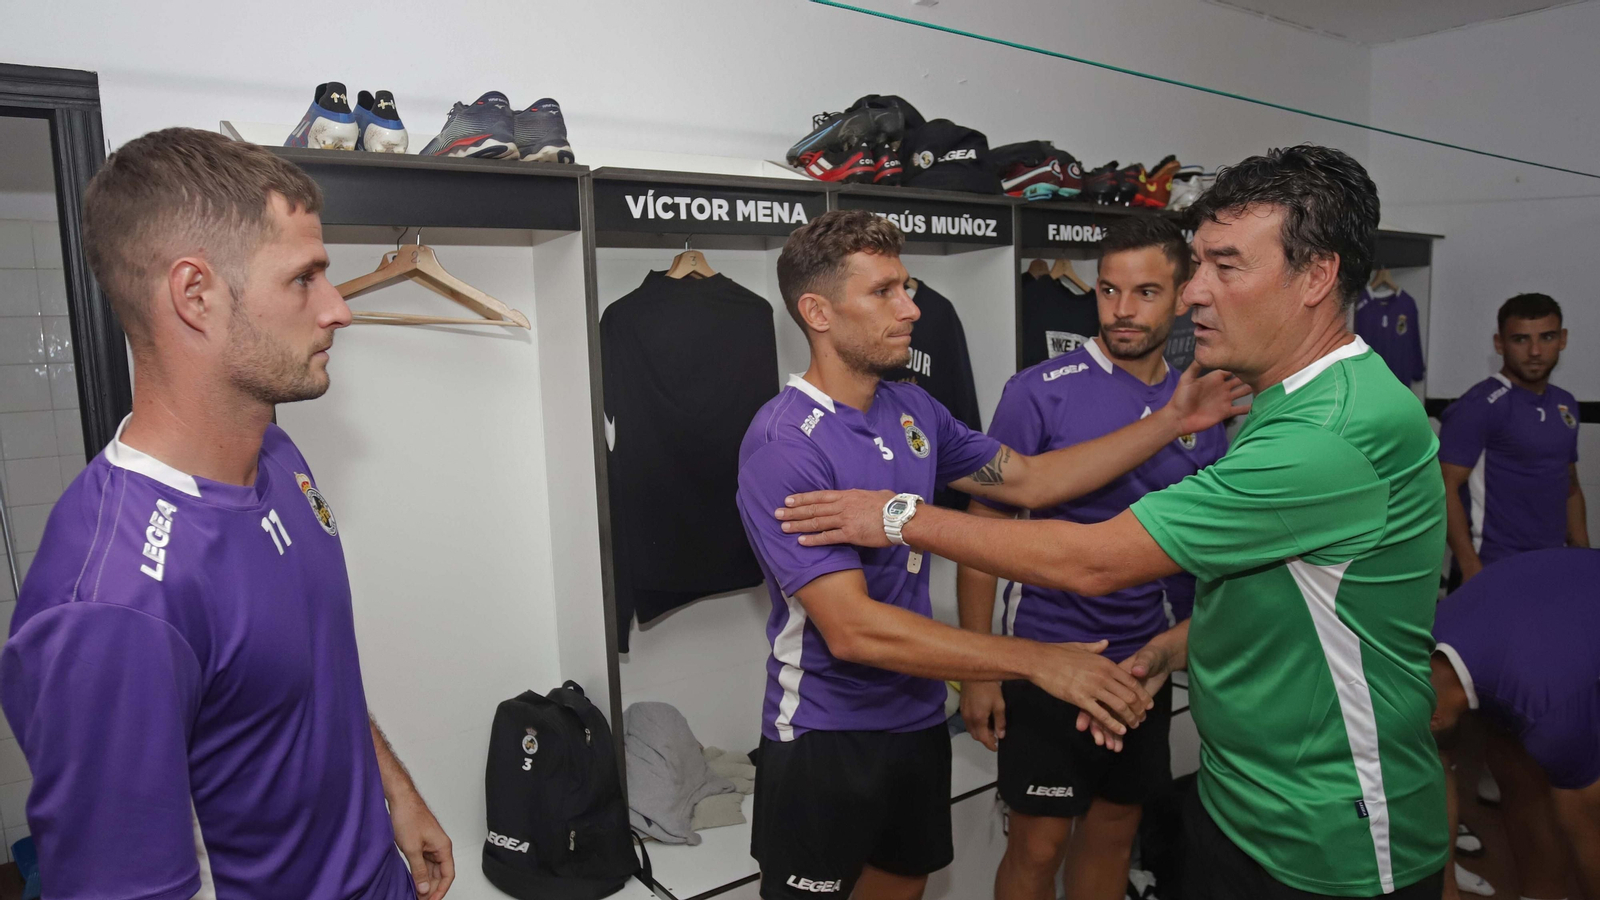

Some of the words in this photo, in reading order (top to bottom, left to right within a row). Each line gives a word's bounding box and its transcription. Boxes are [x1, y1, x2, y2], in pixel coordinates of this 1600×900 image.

[938, 149, 977, 162] GEA
[624, 190, 730, 221] VÍCTOR
[736, 200, 809, 225] MENA
[870, 210, 926, 234] SÚS
[931, 214, 998, 237] MUÑOZ
[1043, 362, 1089, 382] LEGEA
[873, 437, 894, 460] 3
[140, 498, 178, 582] LEGEA
[261, 508, 292, 555] 11
[522, 757, 533, 771] 3
[1026, 784, 1074, 798] LEGEA
[486, 831, 530, 853] EGEA
[786, 874, 841, 892] LEGEA
